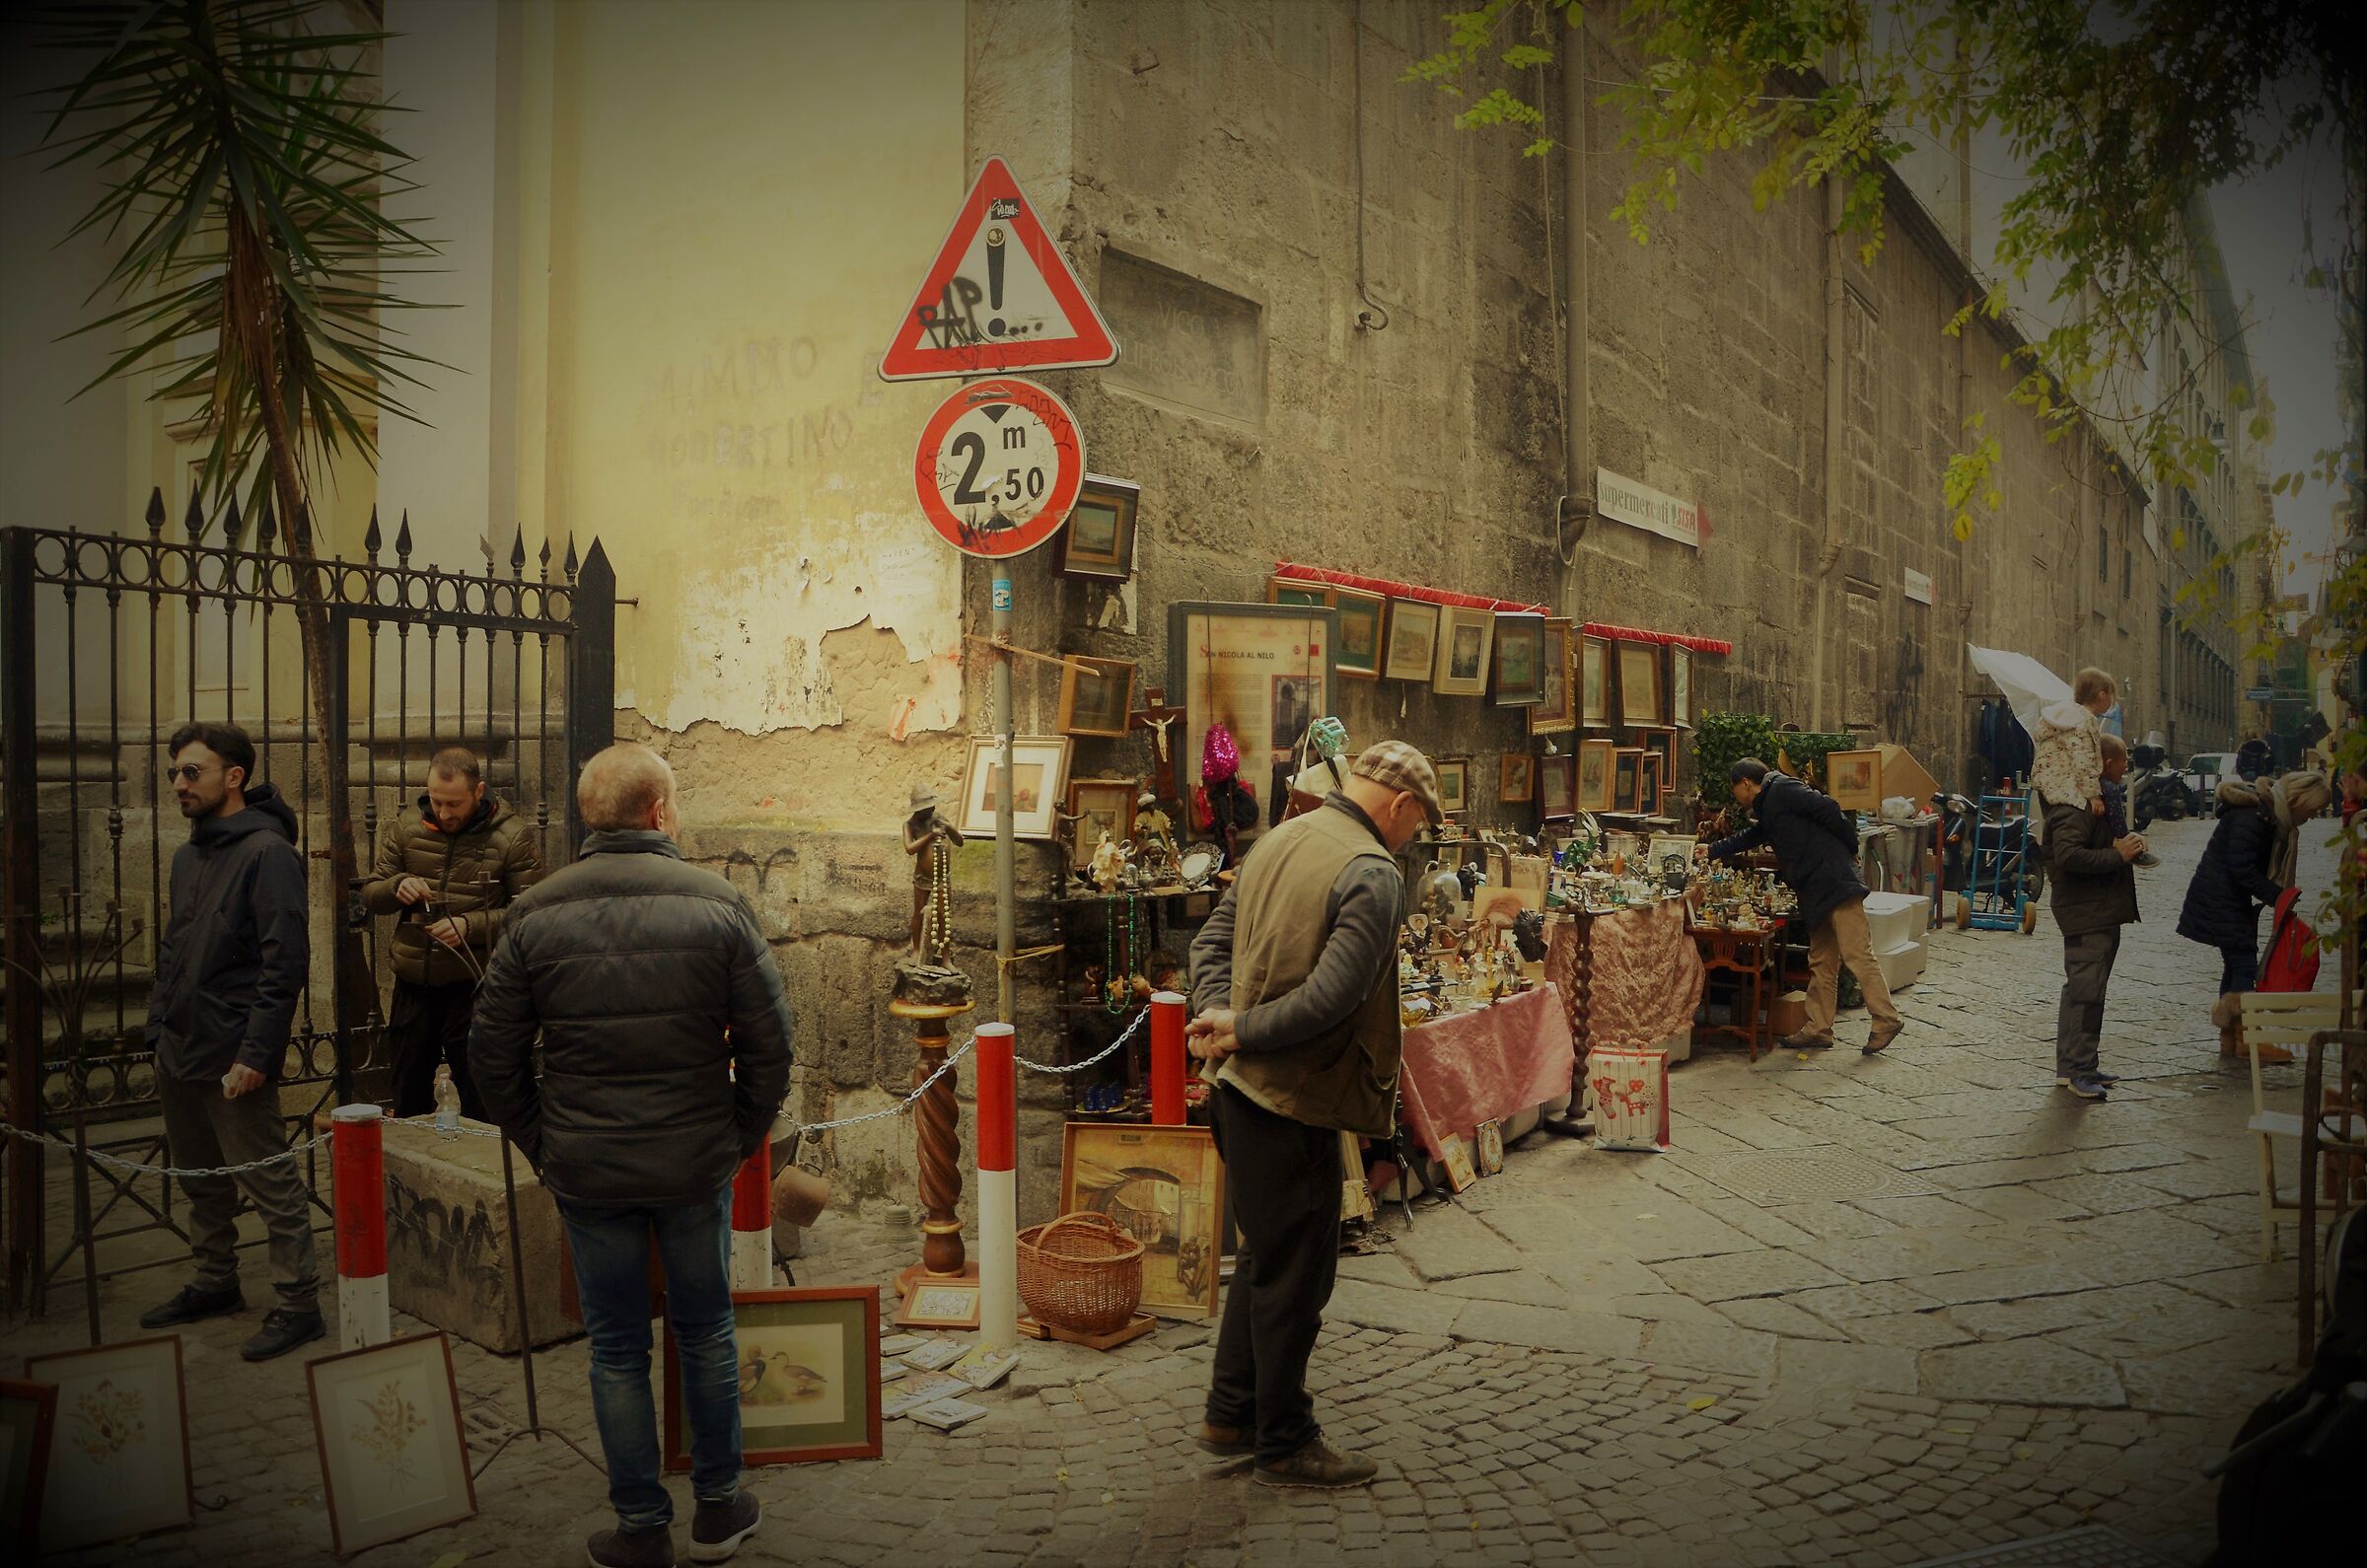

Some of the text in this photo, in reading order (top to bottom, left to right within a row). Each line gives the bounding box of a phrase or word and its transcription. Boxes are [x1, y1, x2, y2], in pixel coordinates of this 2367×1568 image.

[917, 276, 983, 349] RAP
[1003, 426, 1027, 450] m
[1677, 504, 1696, 532] SISA
